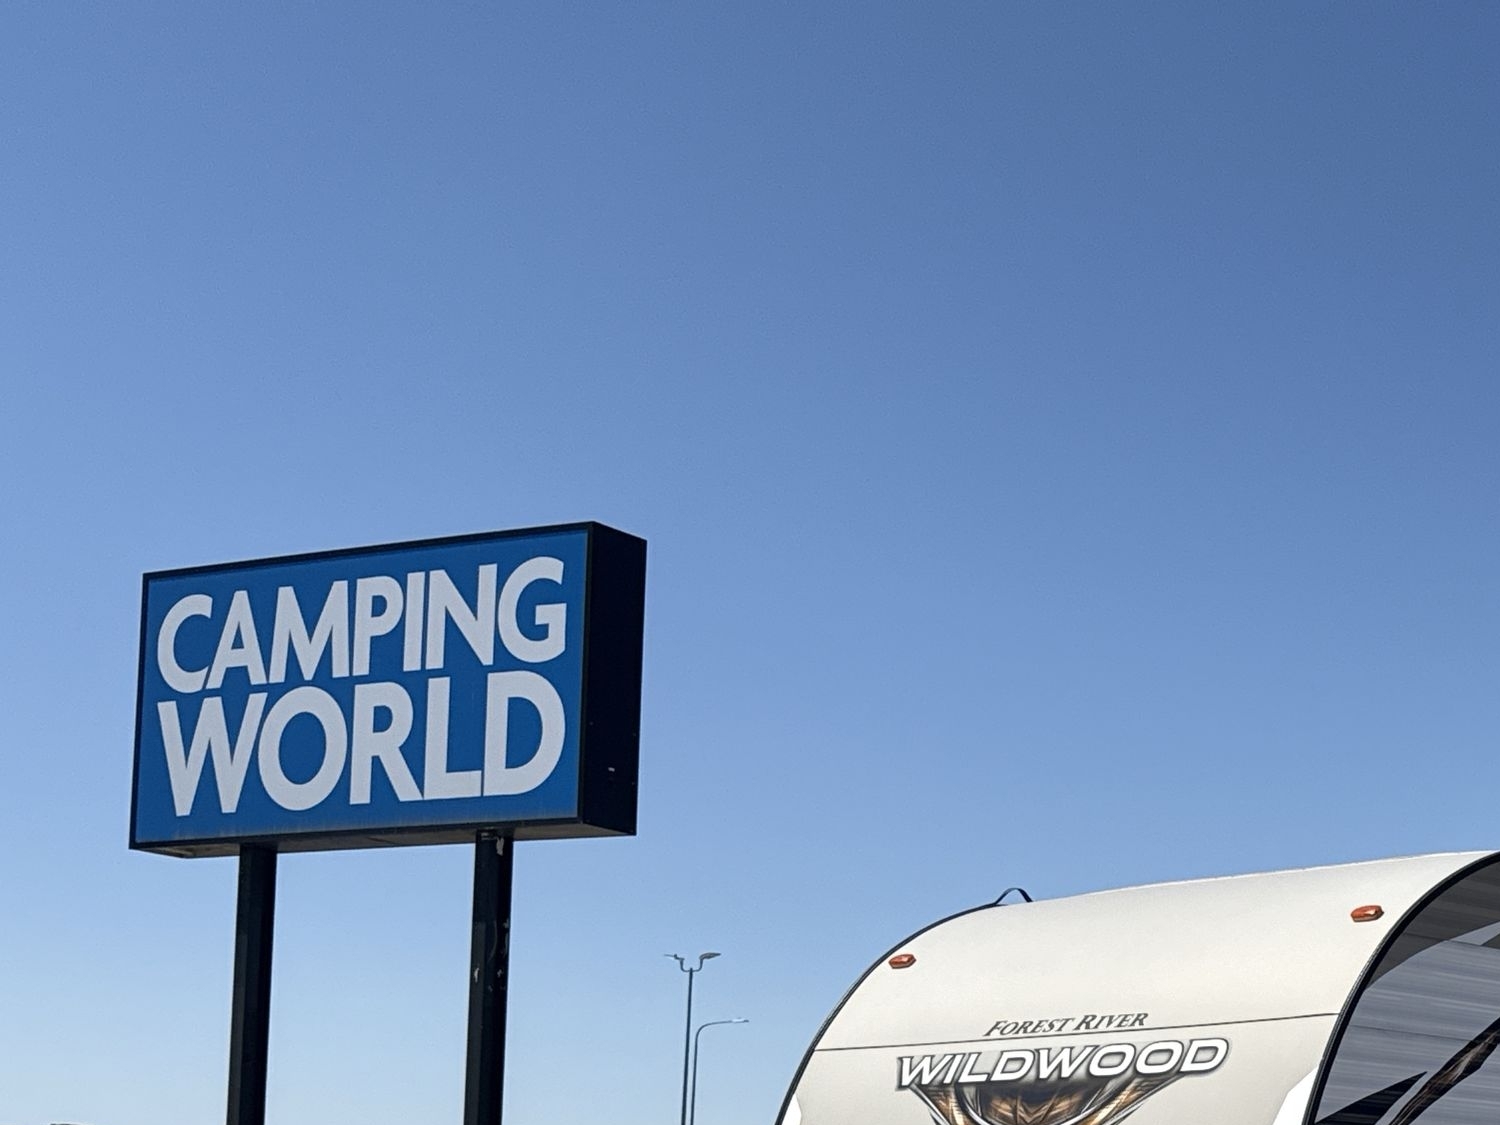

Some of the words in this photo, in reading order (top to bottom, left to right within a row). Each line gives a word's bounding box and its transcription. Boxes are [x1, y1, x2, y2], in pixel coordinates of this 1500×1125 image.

[157, 555, 567, 693] CAMPING
[157, 669, 566, 817] WORLD
[898, 1037, 1230, 1088] WILDWOOD
[983, 1017, 1075, 1037] FOREST
[1074, 1012, 1149, 1032] RIVER
